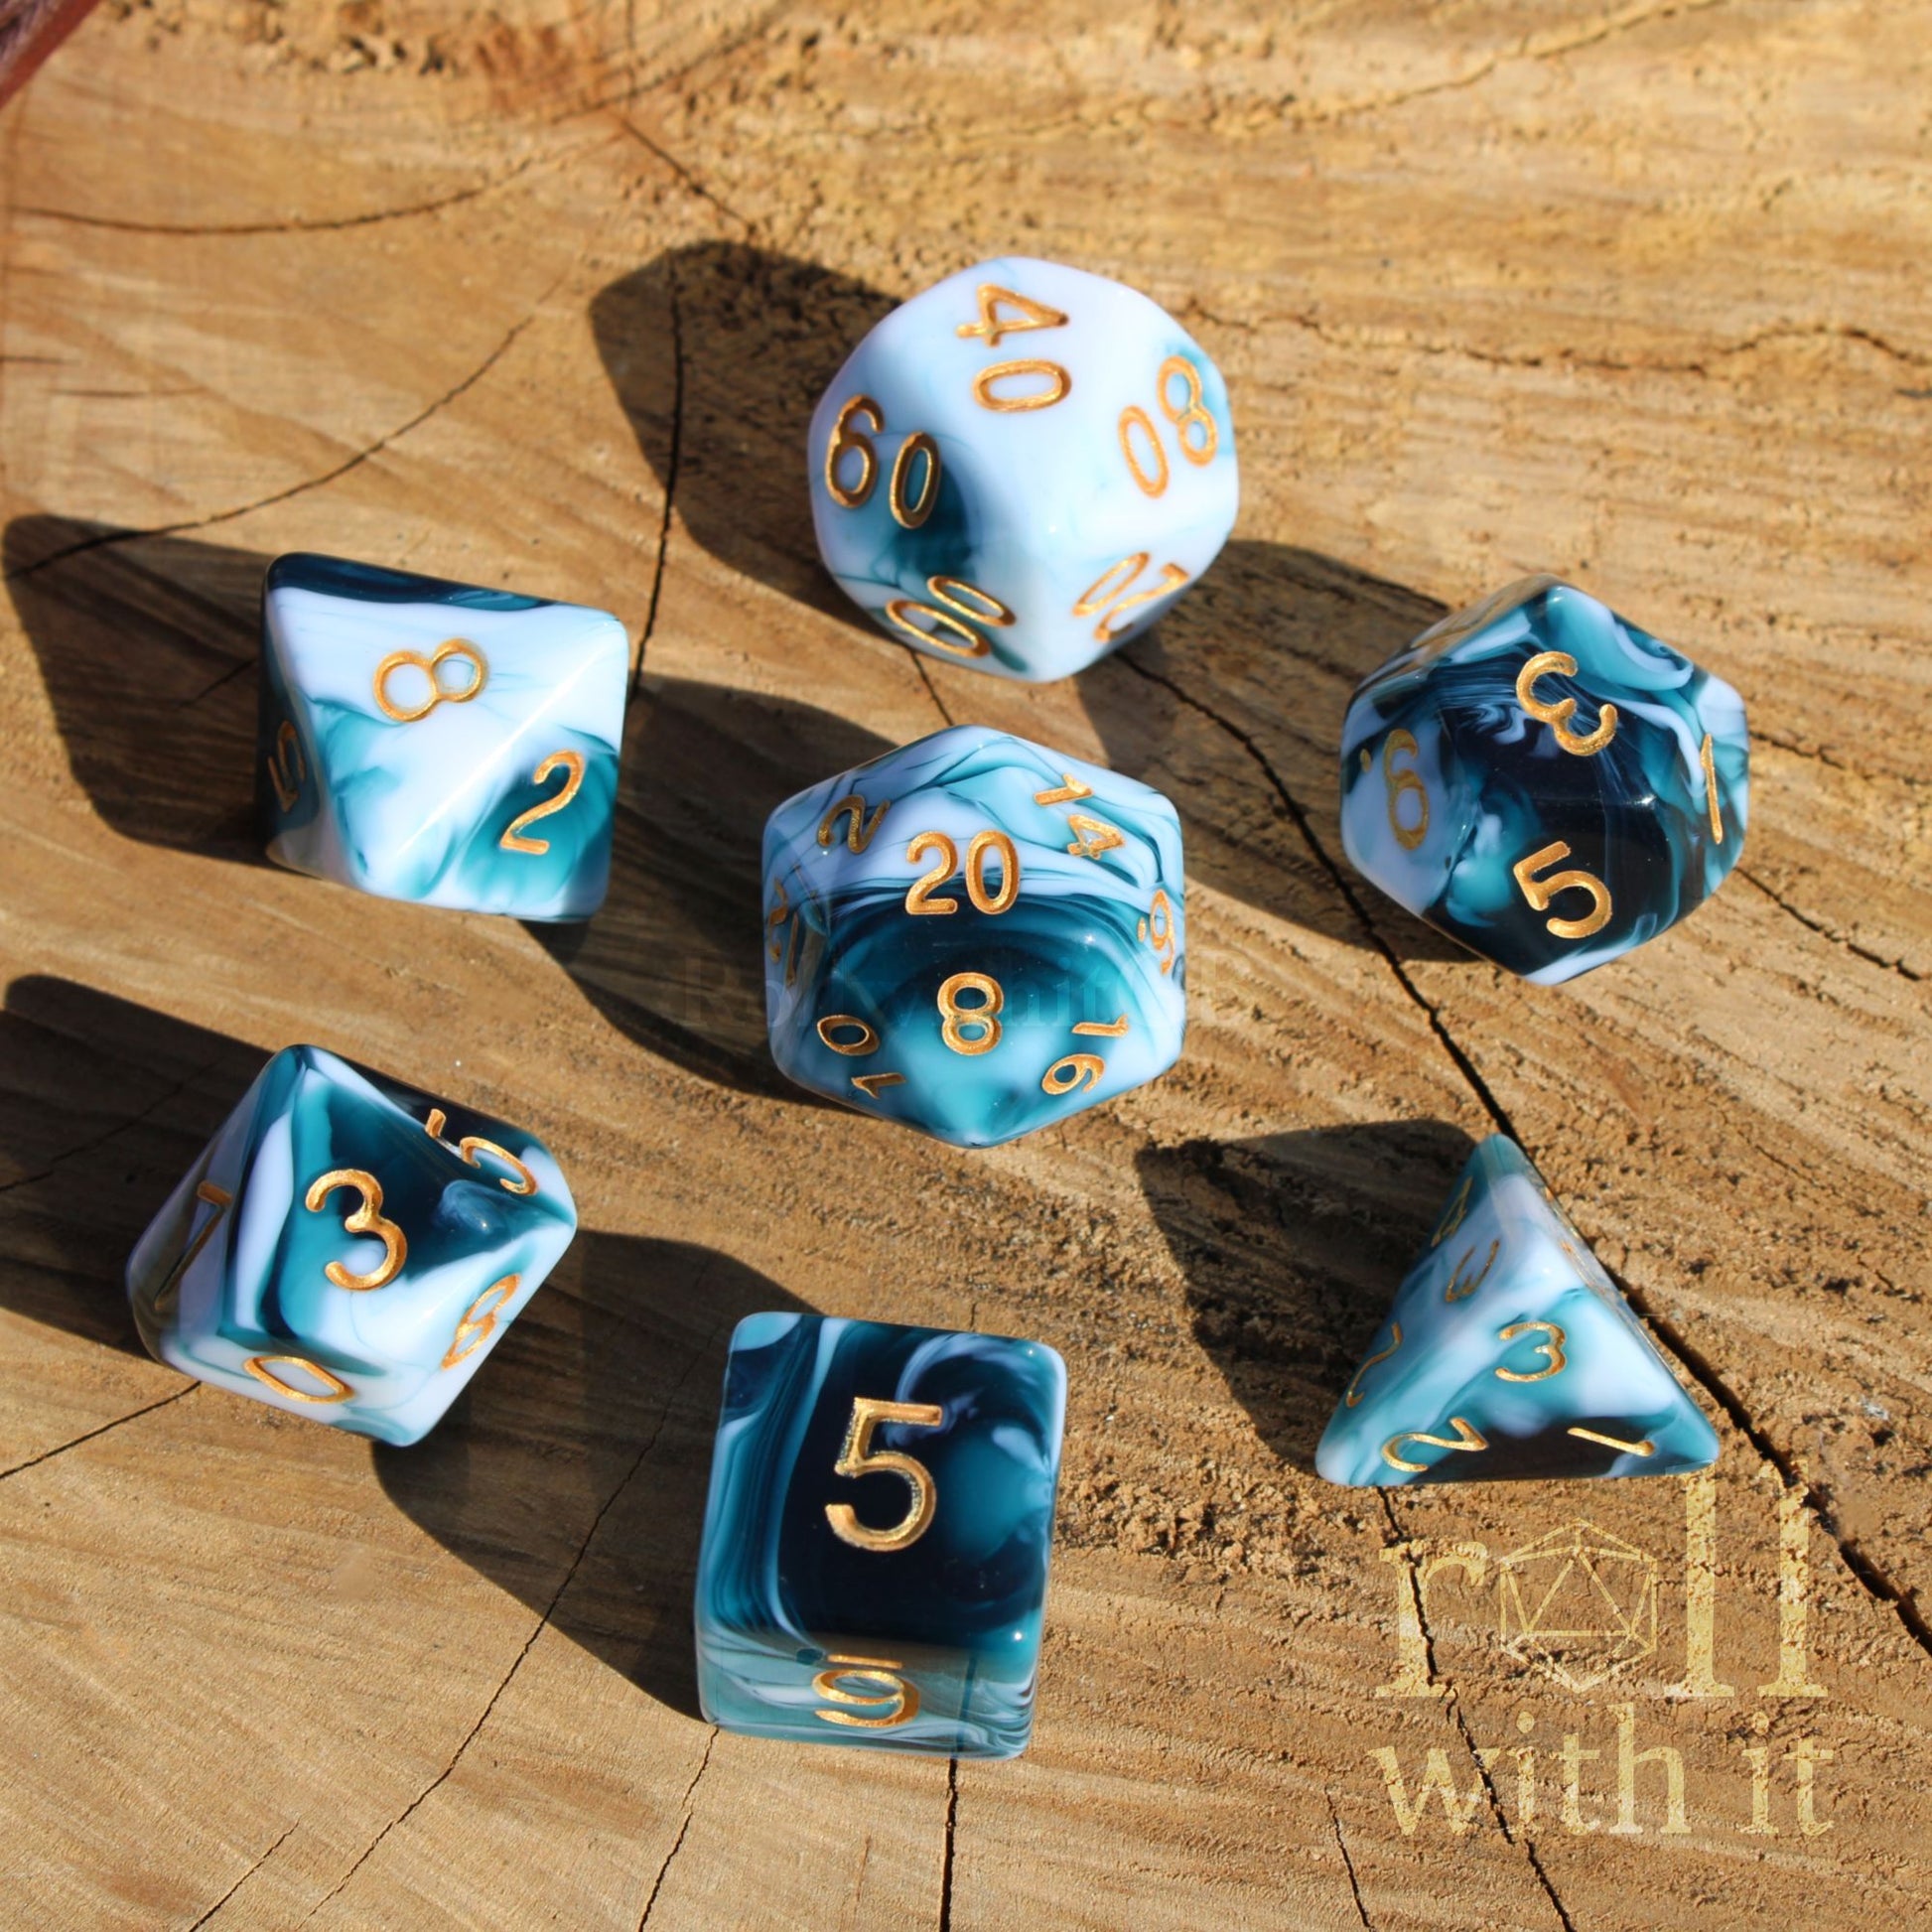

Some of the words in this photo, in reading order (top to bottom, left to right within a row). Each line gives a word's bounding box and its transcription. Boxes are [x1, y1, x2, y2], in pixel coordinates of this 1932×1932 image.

[825, 394, 942, 529] 60
[372, 637, 488, 723] 8
[1515, 650, 1618, 758] 3
[499, 749, 586, 855] 2
[817, 794, 891, 854] 2
[904, 829, 1020, 915] 20
[1513, 840, 1612, 939] 5
[937, 971, 1005, 1056] 8
[425, 1108, 539, 1195] 5
[305, 1169, 408, 1292] 3
[1495, 1320, 1567, 1383] 3
[824, 1396, 943, 1552] 5
[1381, 1417, 1488, 1472] 2
